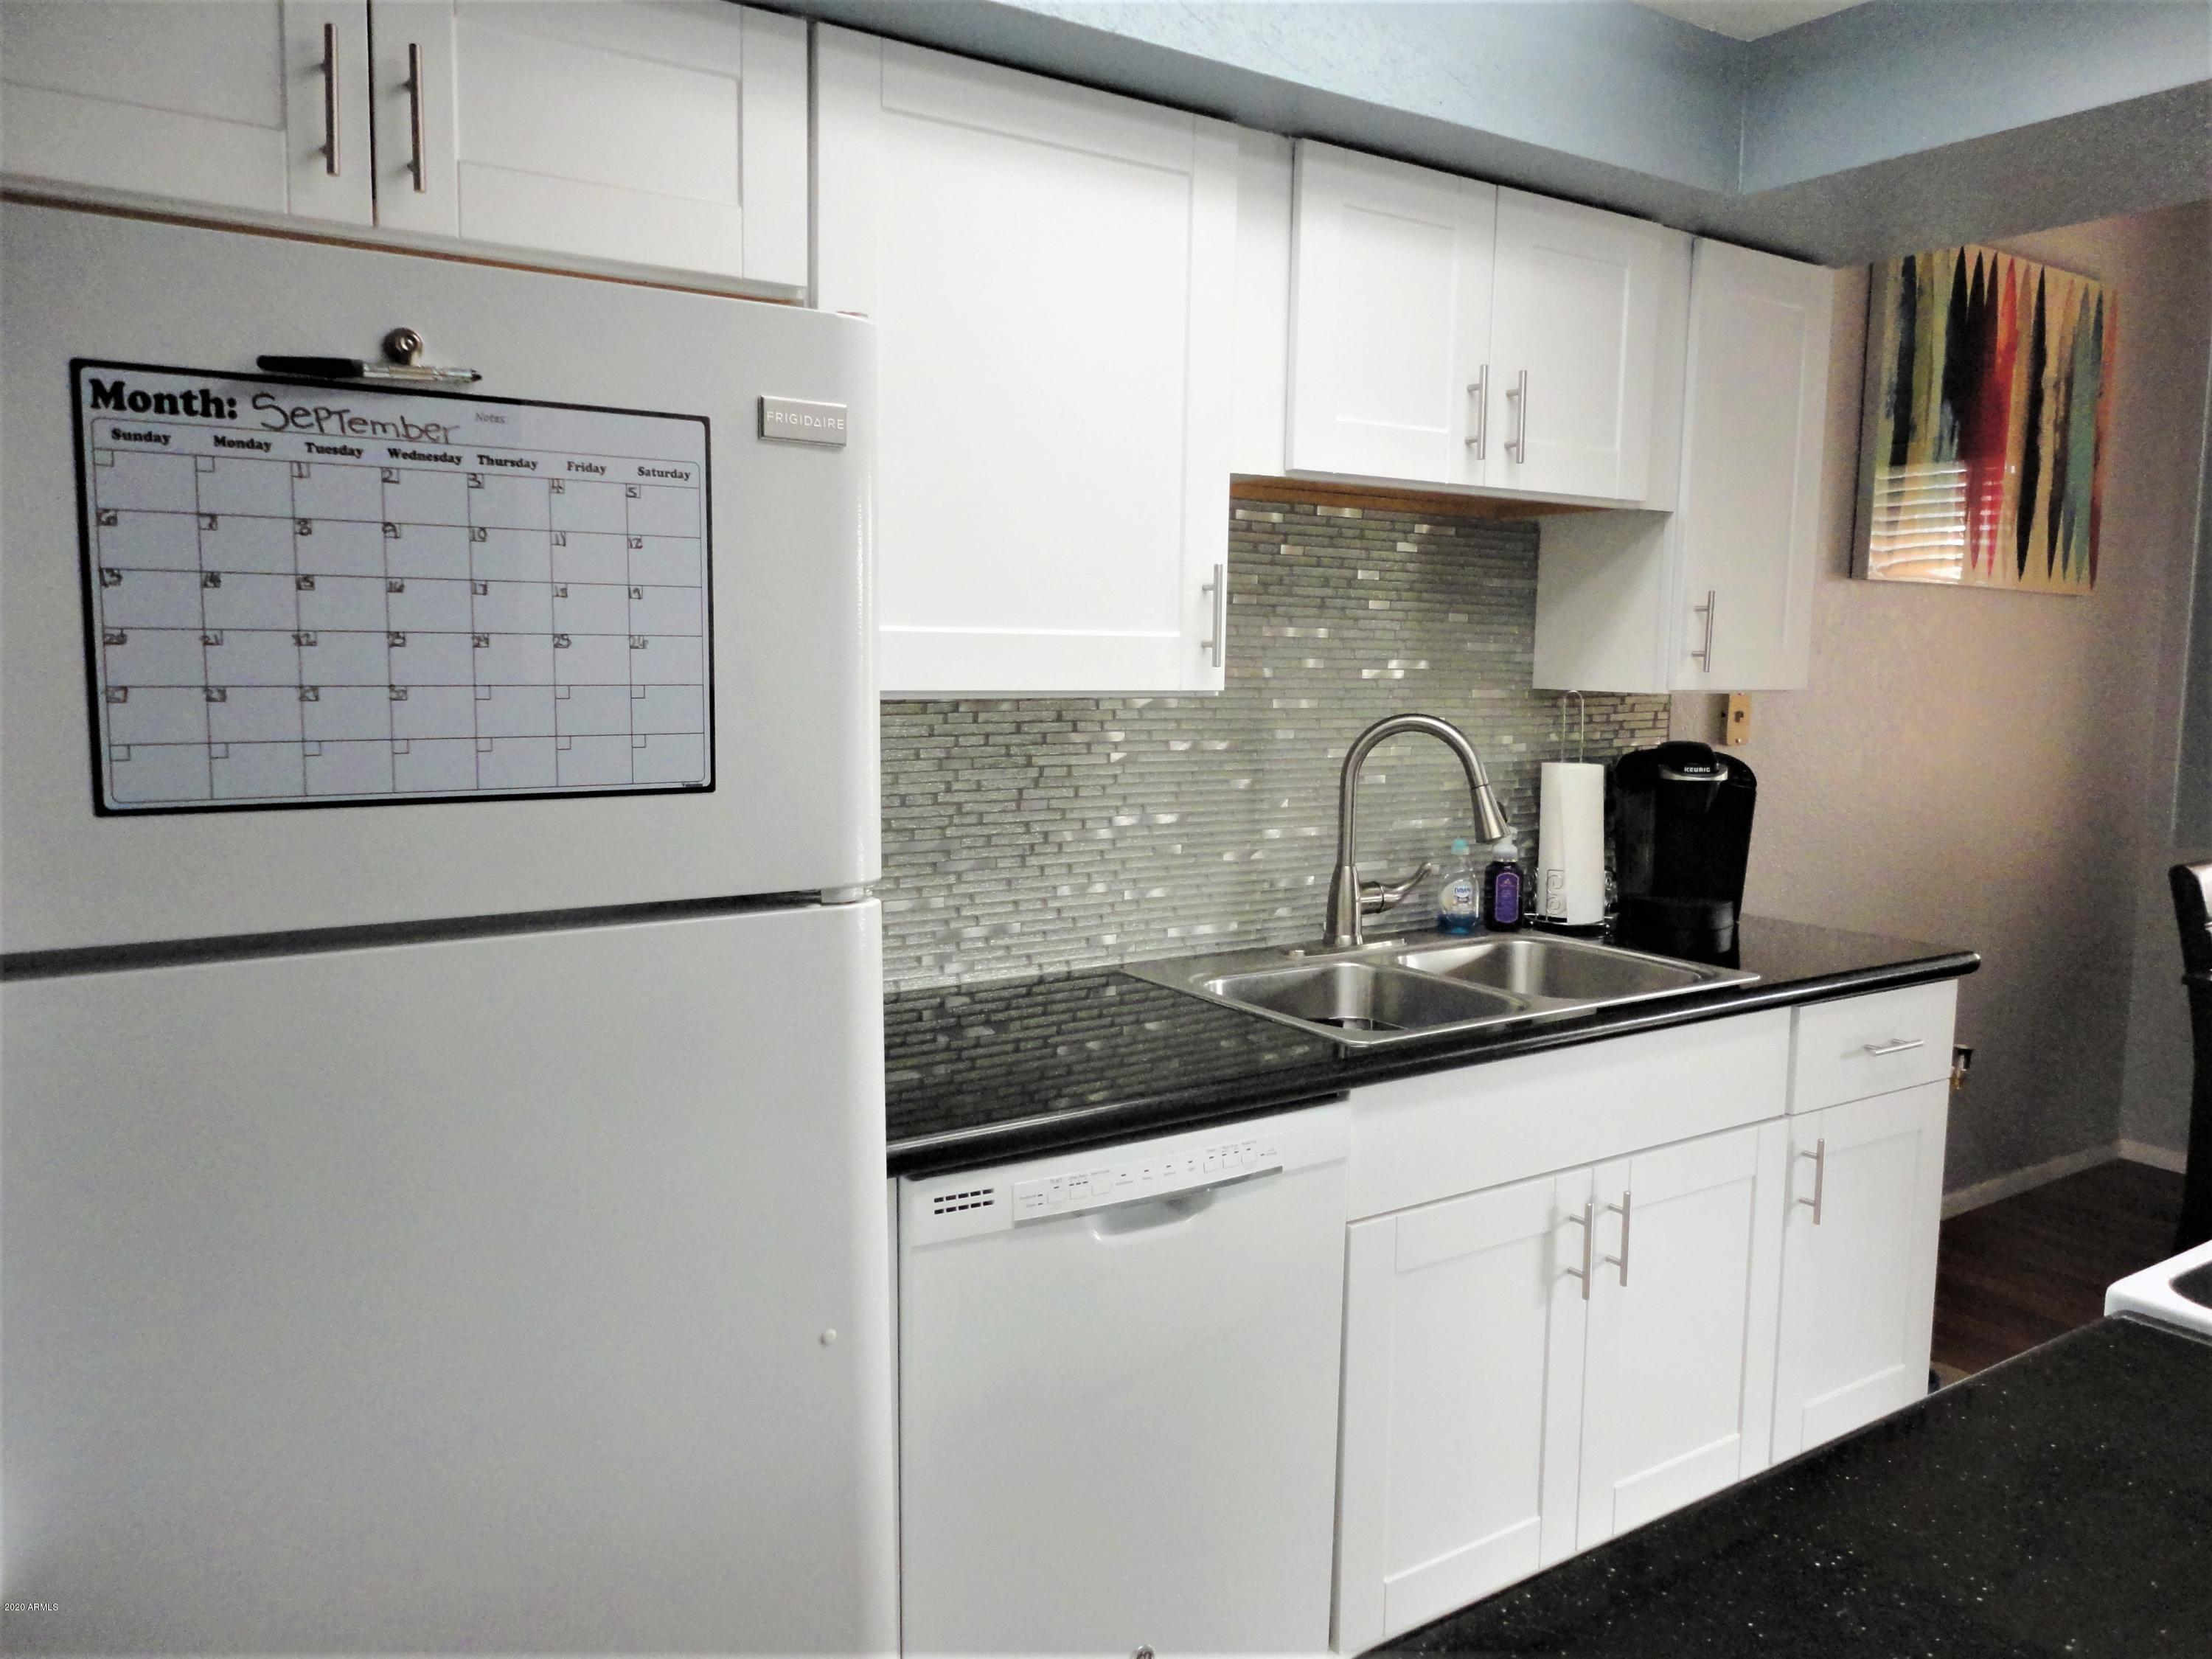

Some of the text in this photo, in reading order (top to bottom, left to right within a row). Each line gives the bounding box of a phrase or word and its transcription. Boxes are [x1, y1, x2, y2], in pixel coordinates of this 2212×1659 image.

[88, 378, 237, 420] Month:
[766, 411, 844, 430] FRIGIDAIRE
[111, 427, 692, 481] Sunday Monday Tuesday Wednesday Thursday Friday Saturday
[381, 467, 399, 484] 2
[468, 473, 482, 488] 3
[552, 478, 563, 494] 4
[625, 487, 637, 498] 5
[298, 518, 313, 536] 8
[472, 526, 487, 542] 10
[554, 531, 566, 546] 11
[627, 536, 643, 549] 12
[98, 566, 122, 588] 13
[627, 586, 642, 600] 19
[553, 633, 571, 649] 25
